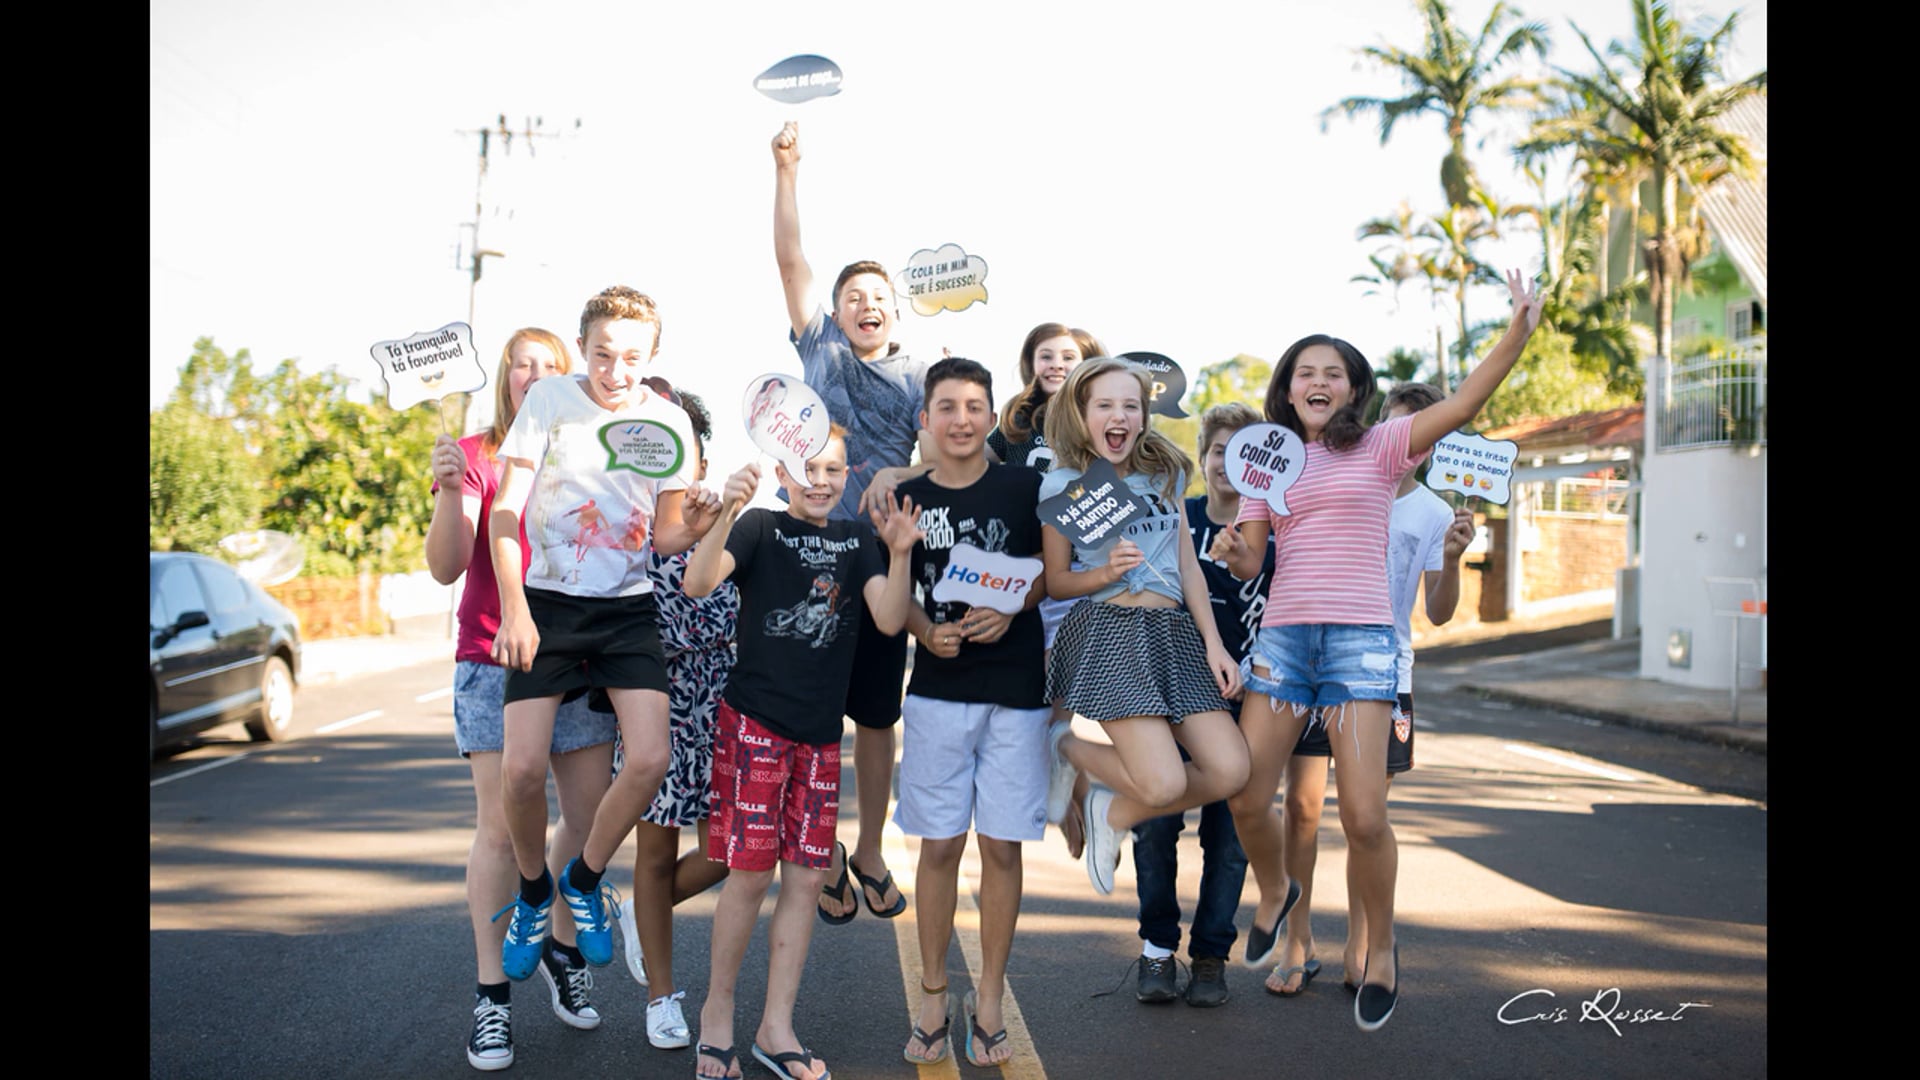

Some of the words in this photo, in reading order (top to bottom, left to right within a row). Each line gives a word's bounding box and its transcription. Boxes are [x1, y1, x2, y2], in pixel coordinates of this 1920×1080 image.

[911, 265, 933, 279] COLA
[936, 262, 948, 275] EM
[951, 259, 968, 272] MIM
[909, 283, 926, 295] QUE
[936, 273, 977, 292] SUCESSO!
[385, 342, 402, 358] Tá
[403, 330, 458, 354] tranquilo
[392, 358, 406, 373] tá
[407, 343, 463, 369] favorável
[800, 403, 816, 422] é
[1263, 430, 1286, 451] Só
[1239, 443, 1271, 467] com
[1270, 456, 1290, 474] os
[1241, 463, 1273, 491] Tops
[1056, 515, 1071, 526] Se
[1078, 497, 1096, 512] sou
[1089, 482, 1114, 500] bom
[1075, 497, 1118, 530] PARTIDO
[1121, 519, 1179, 536] OWER
[801, 536, 821, 548] THE
[947, 565, 1026, 594] Hotel?
